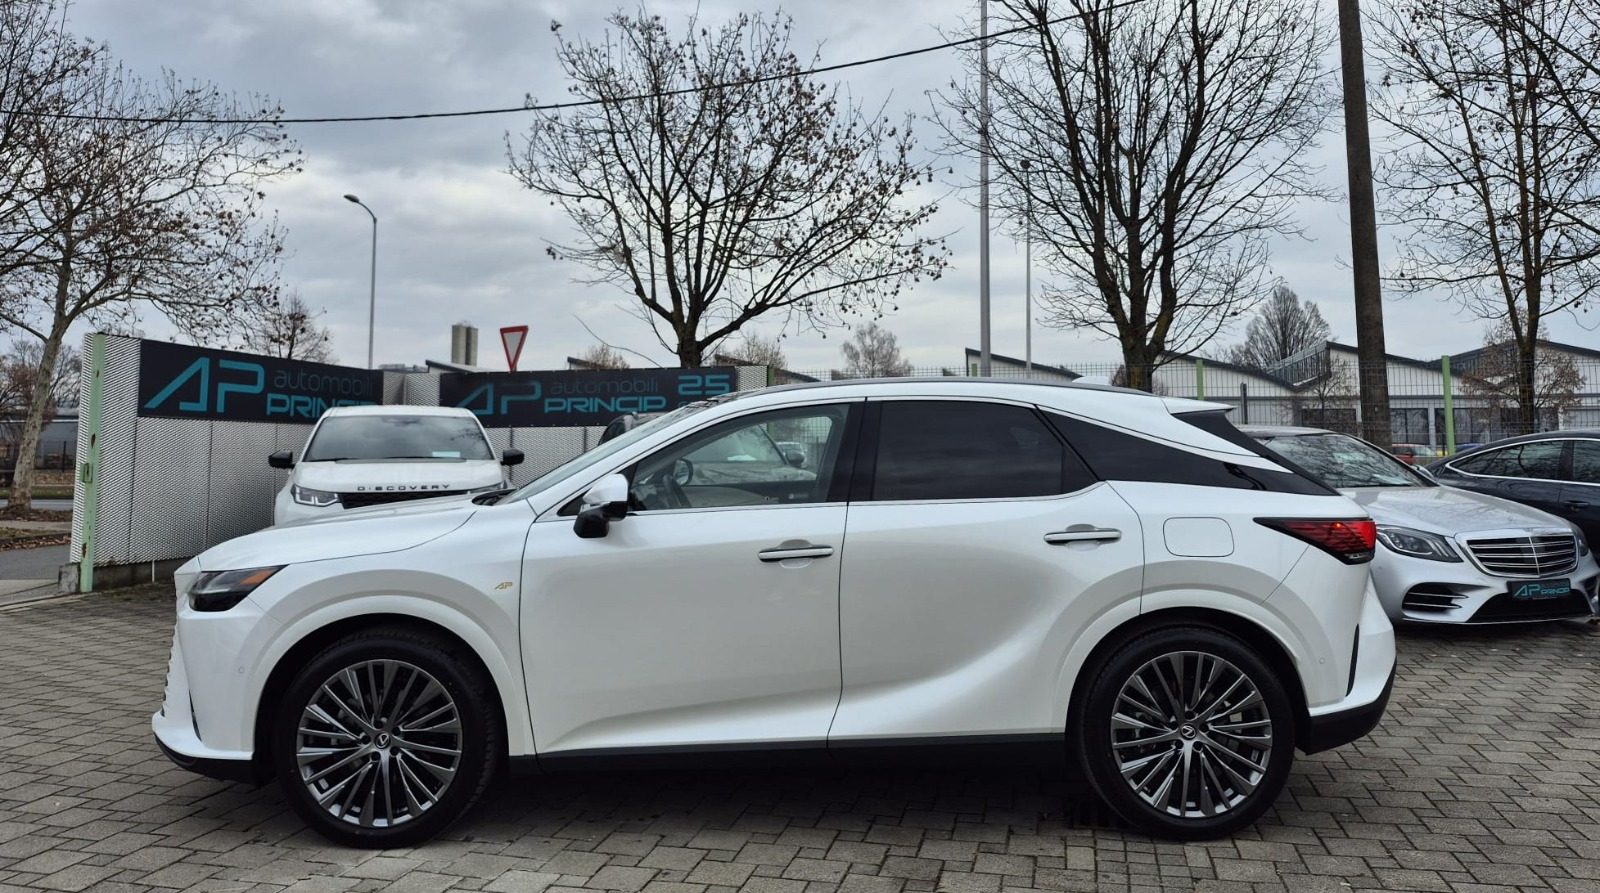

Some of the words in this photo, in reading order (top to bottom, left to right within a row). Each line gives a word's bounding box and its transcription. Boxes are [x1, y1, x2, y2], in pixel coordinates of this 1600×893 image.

[144, 357, 264, 413] AP
[274, 369, 373, 396] automobili
[551, 378, 658, 394] automobili
[678, 374, 730, 395] 25
[456, 381, 542, 415] AP
[544, 396, 667, 413] PRINCIP
